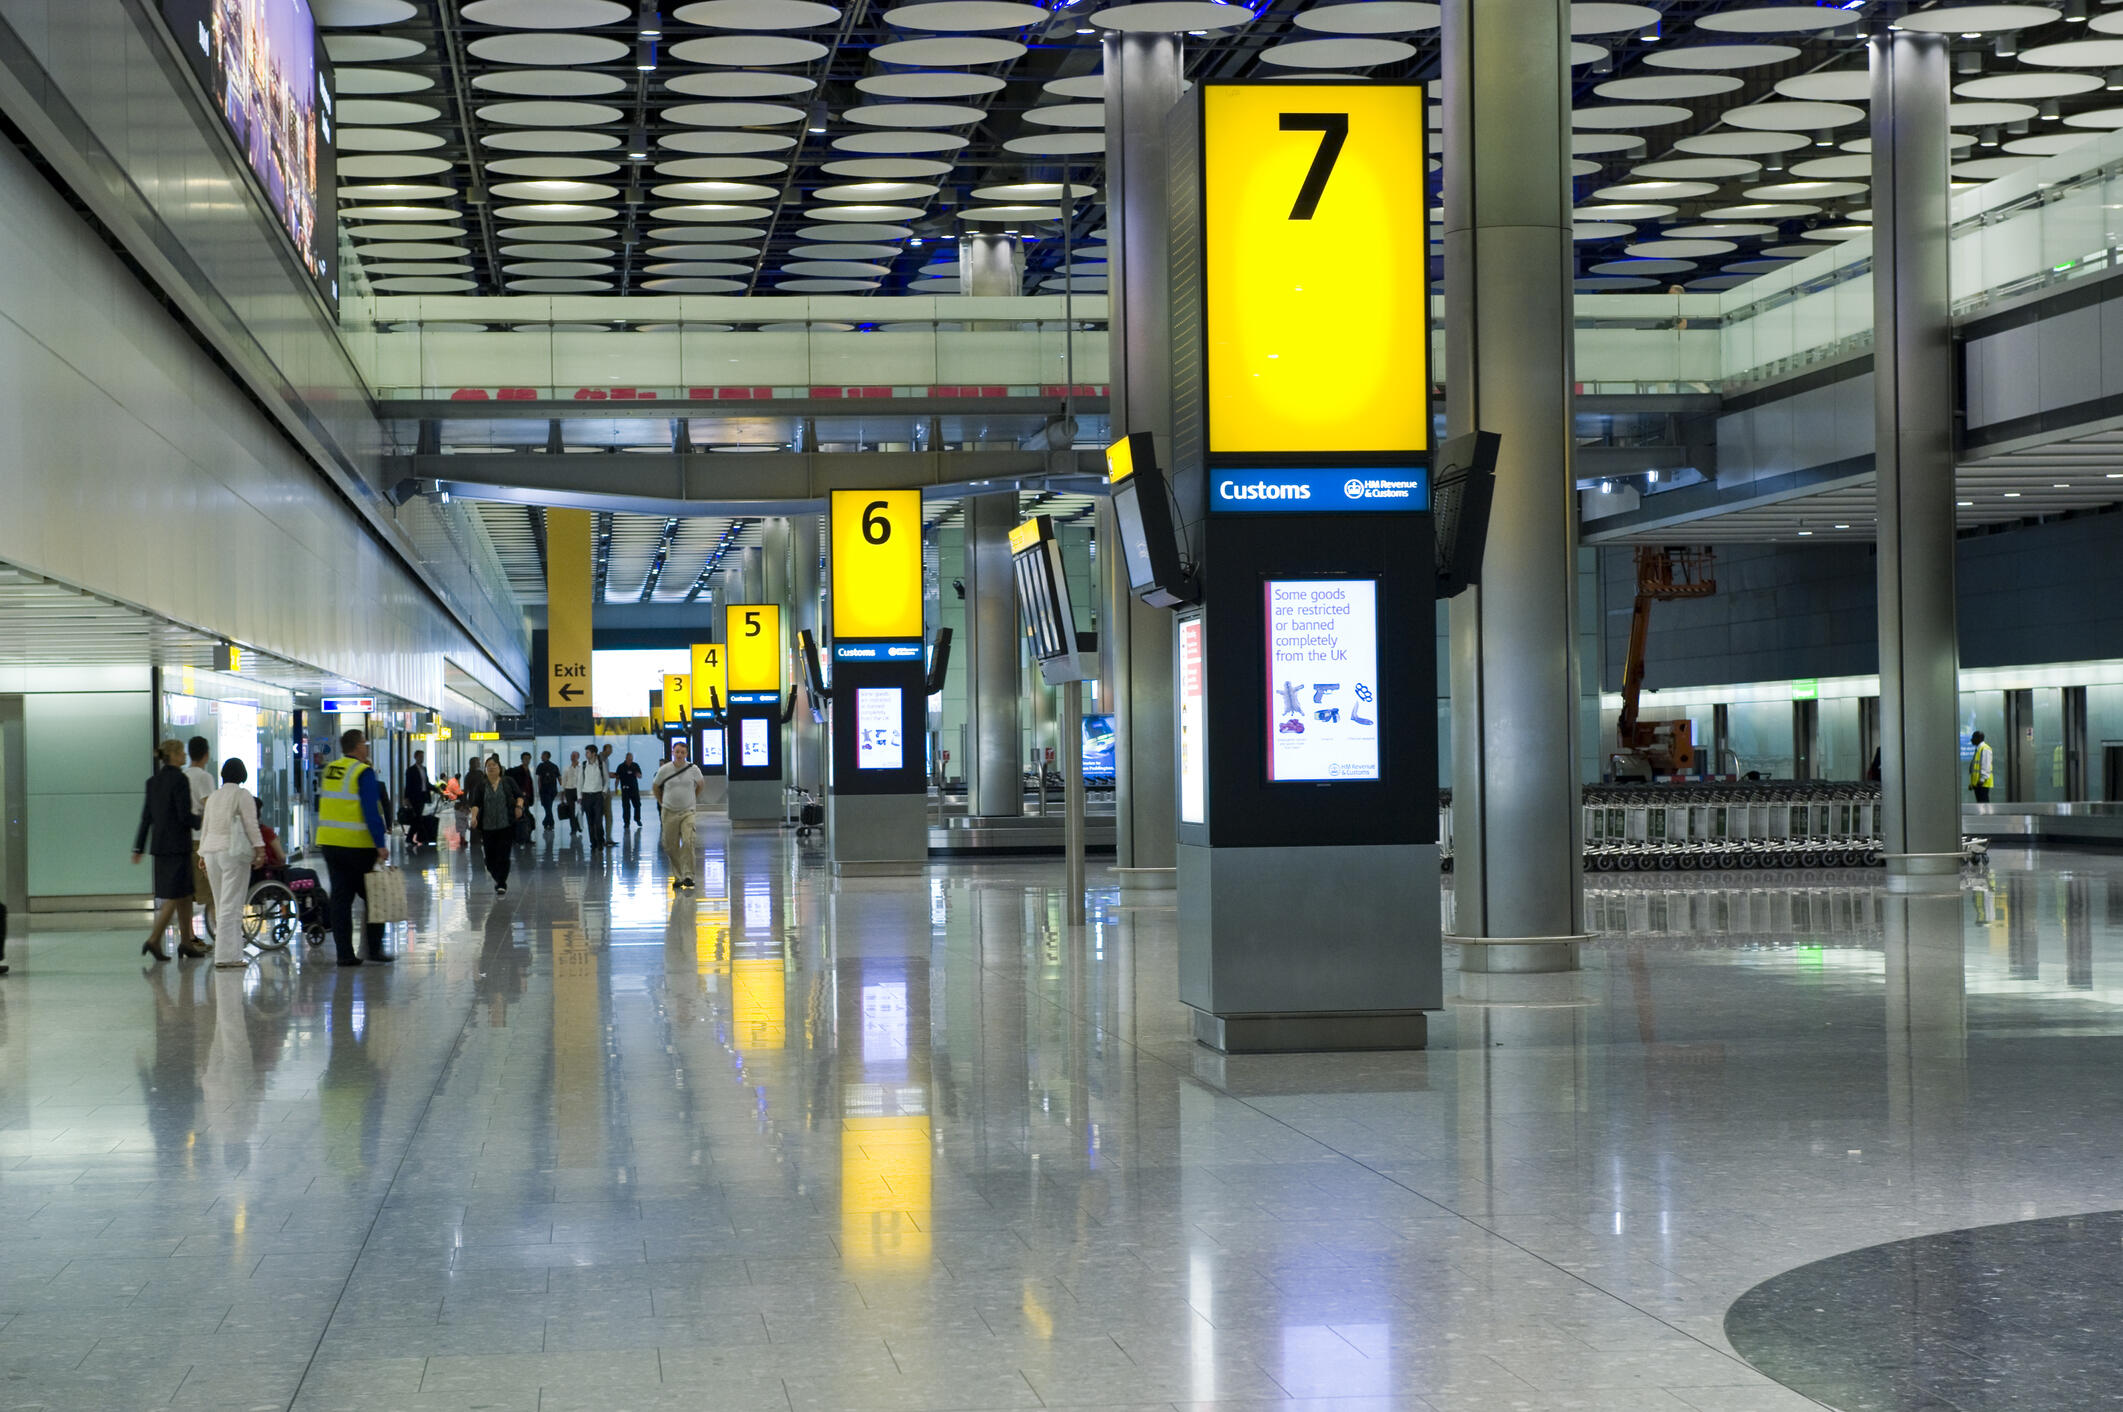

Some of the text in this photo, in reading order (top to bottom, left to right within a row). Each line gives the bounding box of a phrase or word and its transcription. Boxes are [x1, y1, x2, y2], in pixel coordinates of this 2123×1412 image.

[1278, 112, 1349, 220] 7
[1219, 480, 1311, 500] Customs
[1364, 480, 1418, 489] HM Revenue
[1364, 489, 1409, 498] & Customs
[862, 500, 891, 545] 6
[1275, 588, 1346, 603] Some goods
[1275, 603, 1351, 616] are restricted
[745, 611, 761, 637] 5
[1275, 618, 1335, 631] or banned
[1276, 633, 1338, 649] completely
[704, 648, 718, 668] 4
[1276, 649, 1348, 662] from the UK
[554, 663, 586, 677] Exit
[673, 677, 683, 692] 3
